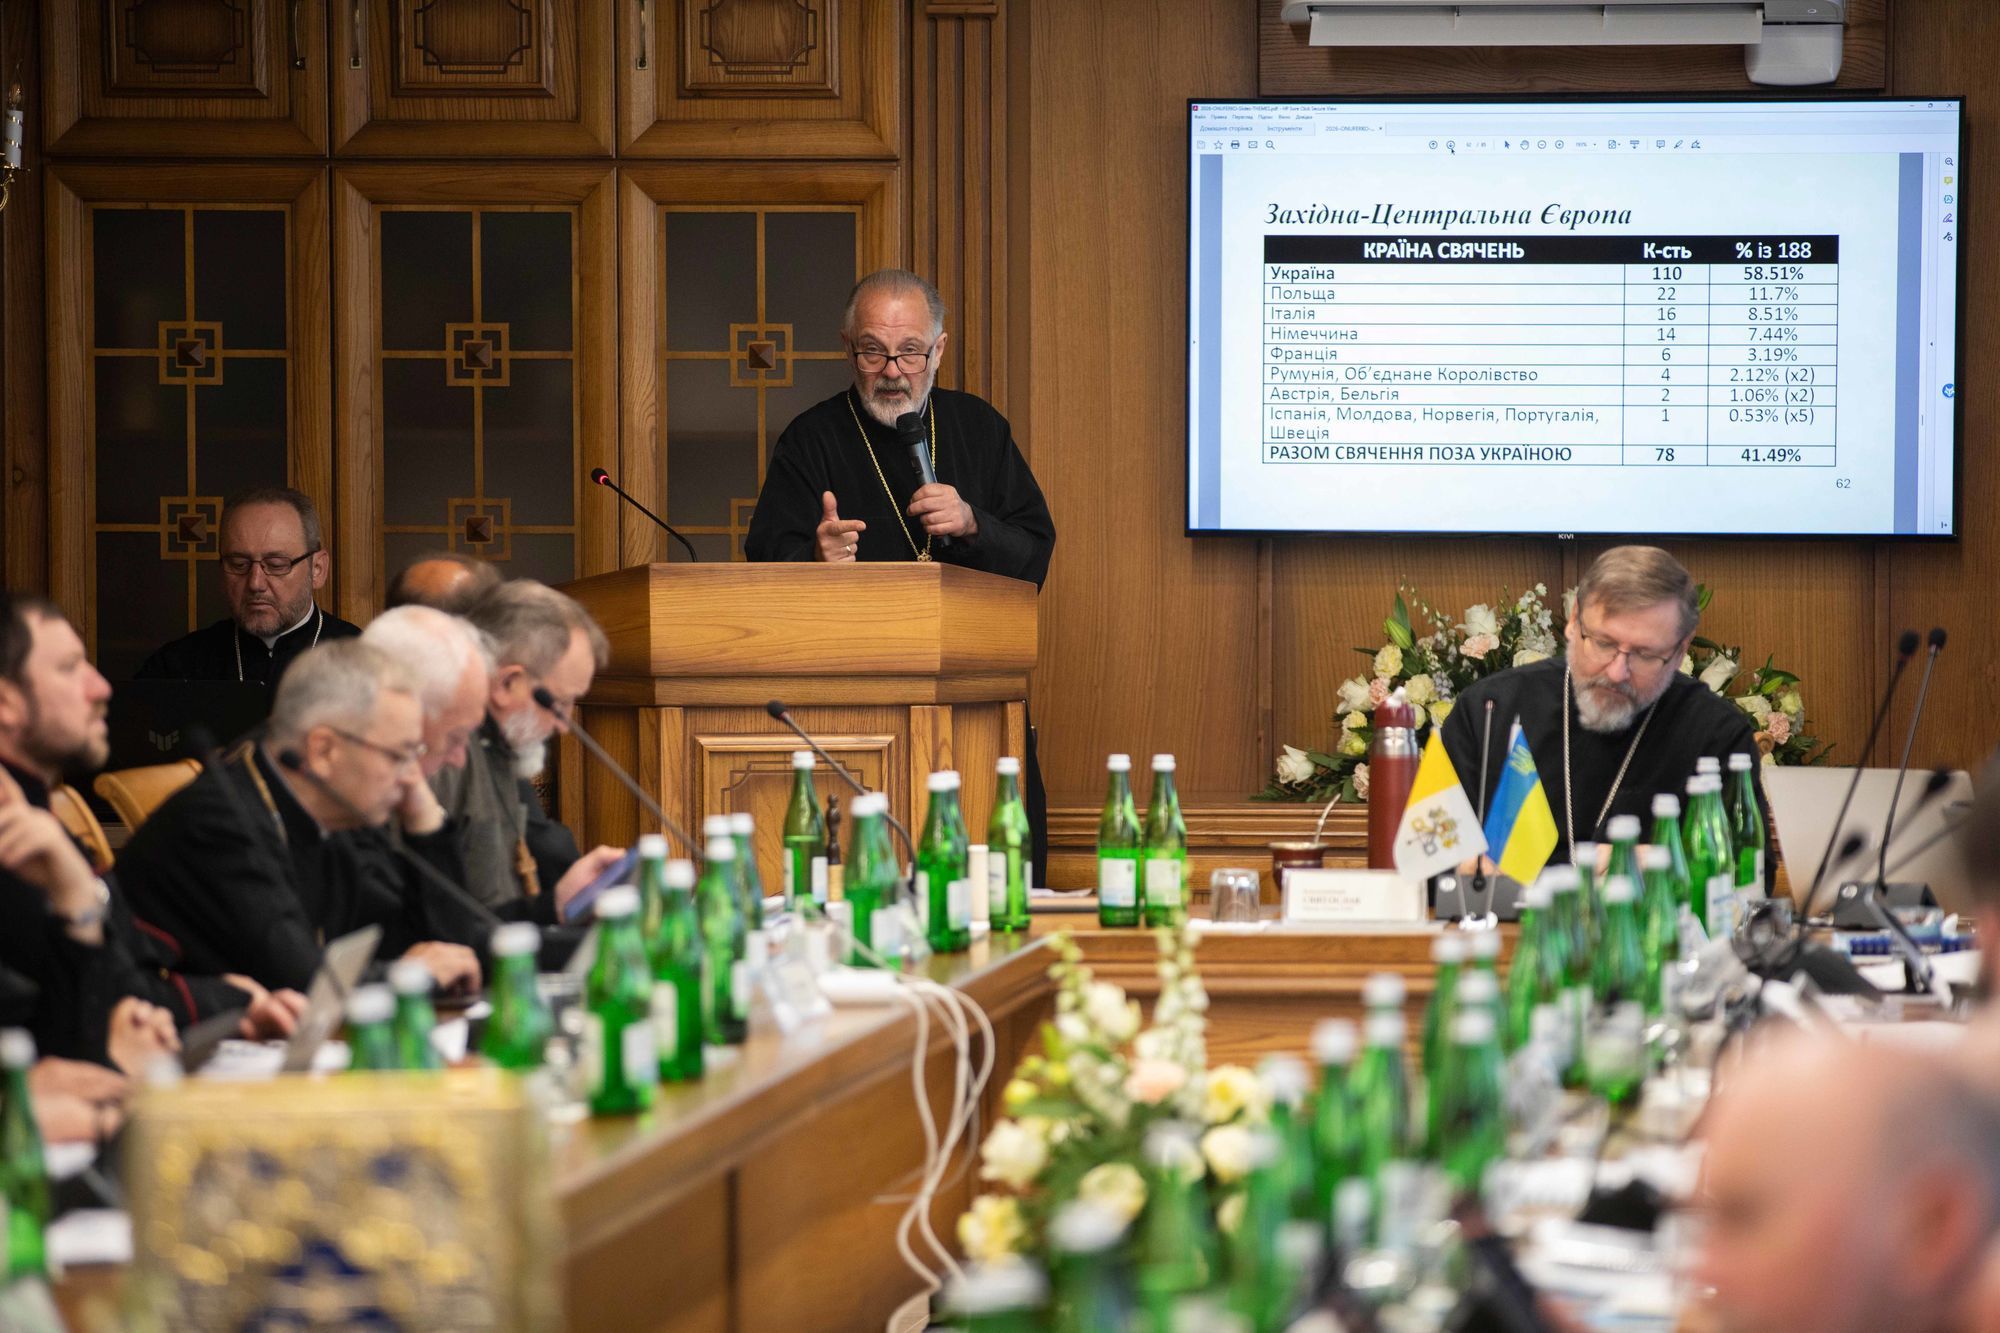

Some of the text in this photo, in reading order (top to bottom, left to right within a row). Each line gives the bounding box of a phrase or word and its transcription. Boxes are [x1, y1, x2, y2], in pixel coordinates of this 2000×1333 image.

[1264, 203, 1632, 230] Західна-Центральна Європа
[1364, 238, 1524, 259] КРАЇНА СВЯЧЕНЬ
[1643, 242, 1692, 259] К-сть
[1735, 242, 1812, 259] % із 188
[1271, 266, 1335, 283] Україна
[1653, 267, 1682, 281] 110
[1744, 267, 1804, 281] 58.51%
[1271, 286, 1335, 302] Польща
[1657, 287, 1676, 301] 22
[1749, 287, 1799, 301] 11.7%
[1271, 307, 1315, 320] Італія
[1657, 307, 1676, 321] 16
[1748, 307, 1798, 321] 8.51%
[1271, 327, 1358, 341] Німеччина
[1657, 327, 1676, 341] 14
[1748, 327, 1798, 341] 7.44%
[1270, 347, 1337, 363] Франція
[1662, 348, 1671, 362] 6
[1748, 348, 1798, 362] 3.19%
[1271, 367, 1339, 383] Румунія,
[1438, 368, 1538, 382] Королівство
[1661, 368, 1671, 381] 4
[1730, 368, 1779, 382] 2.12%
[1270, 387, 1399, 403] Австрія, Бельгія
[1661, 388, 1670, 402] 2
[1731, 388, 1779, 402] 1.06%
[1270, 407, 1599, 425] Іспанія, Молдова, Норвегія, Португалія,
[1662, 409, 1670, 422] 1
[1729, 408, 1779, 423] 0.53%
[1270, 426, 1329, 442] Швеція
[1270, 443, 1571, 461] РАЗОМ СВЯЧЕННЯ ПОЗА УКРАЇНОЮ
[1656, 448, 1674, 462] 78
[1741, 448, 1801, 463] 41.49%
[1836, 478, 1851, 489] 62
